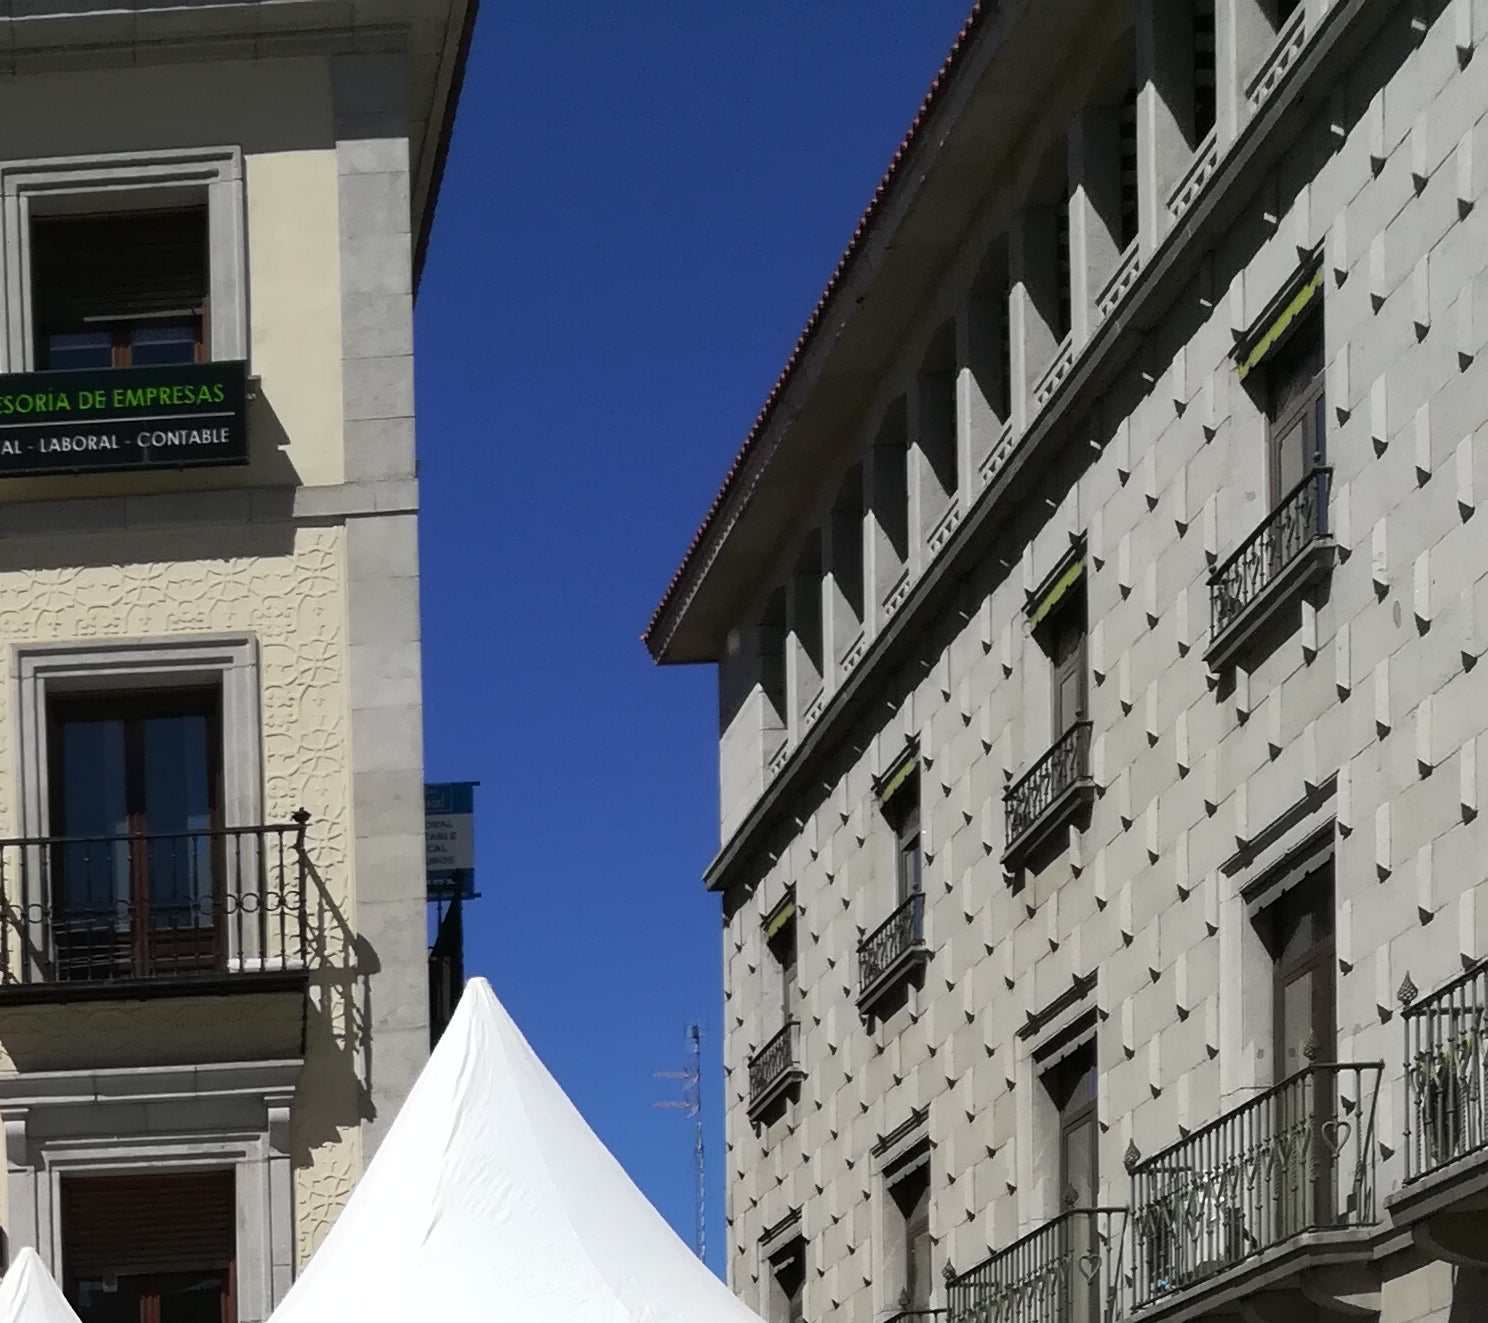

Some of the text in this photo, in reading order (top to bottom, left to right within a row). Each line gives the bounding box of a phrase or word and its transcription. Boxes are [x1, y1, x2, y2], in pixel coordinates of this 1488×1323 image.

[78, 389, 106, 410] DE
[113, 384, 225, 408] EMPRESAS
[40, 434, 120, 453] LABORAL
[137, 427, 230, 447] CONTABLE
